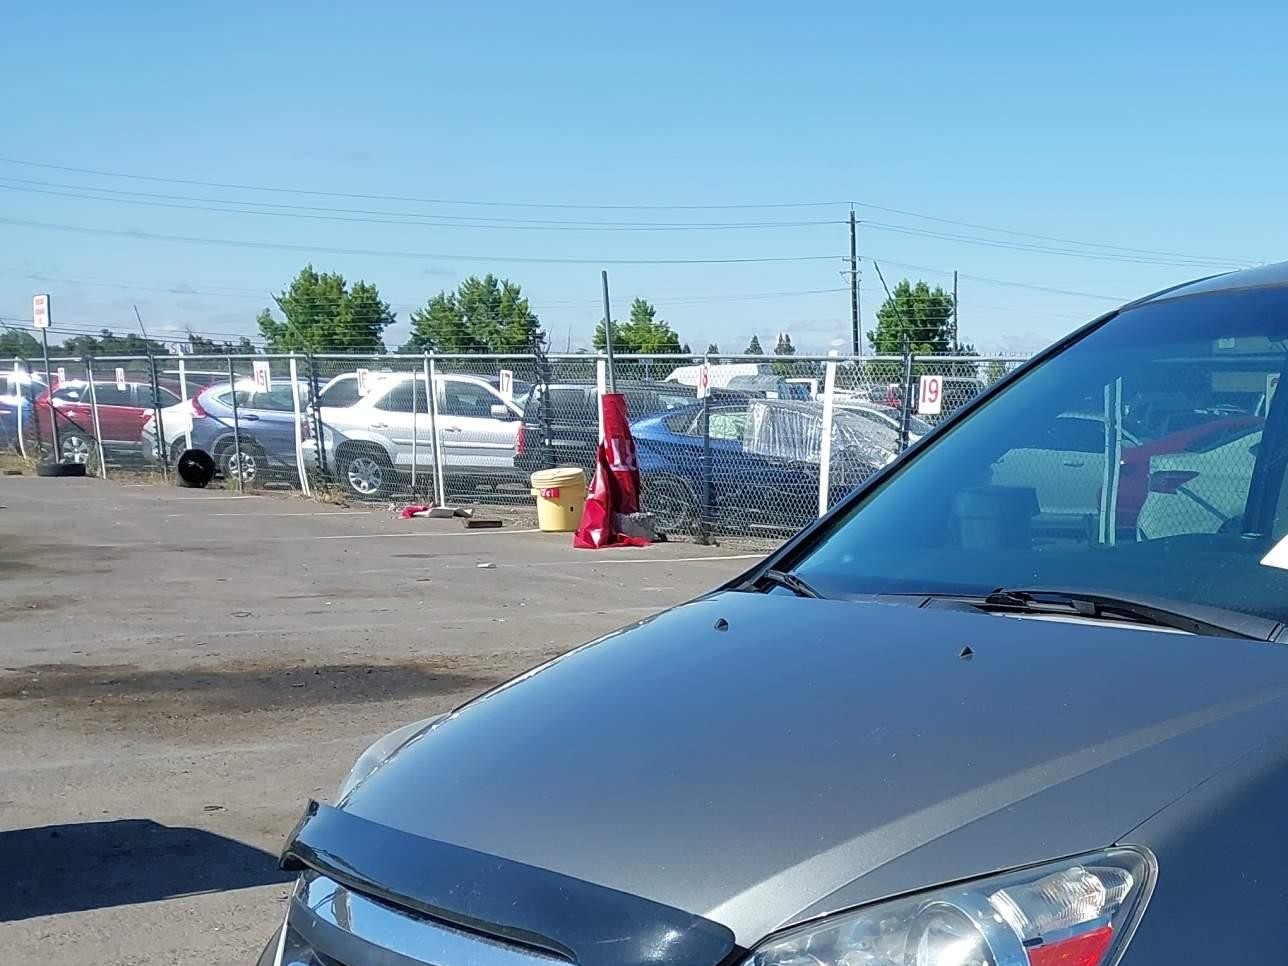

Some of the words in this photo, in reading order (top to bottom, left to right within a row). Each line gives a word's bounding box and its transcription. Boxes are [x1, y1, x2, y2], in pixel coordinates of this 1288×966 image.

[501, 372, 511, 392] 17
[699, 365, 708, 388] 18
[921, 378, 939, 403] 19
